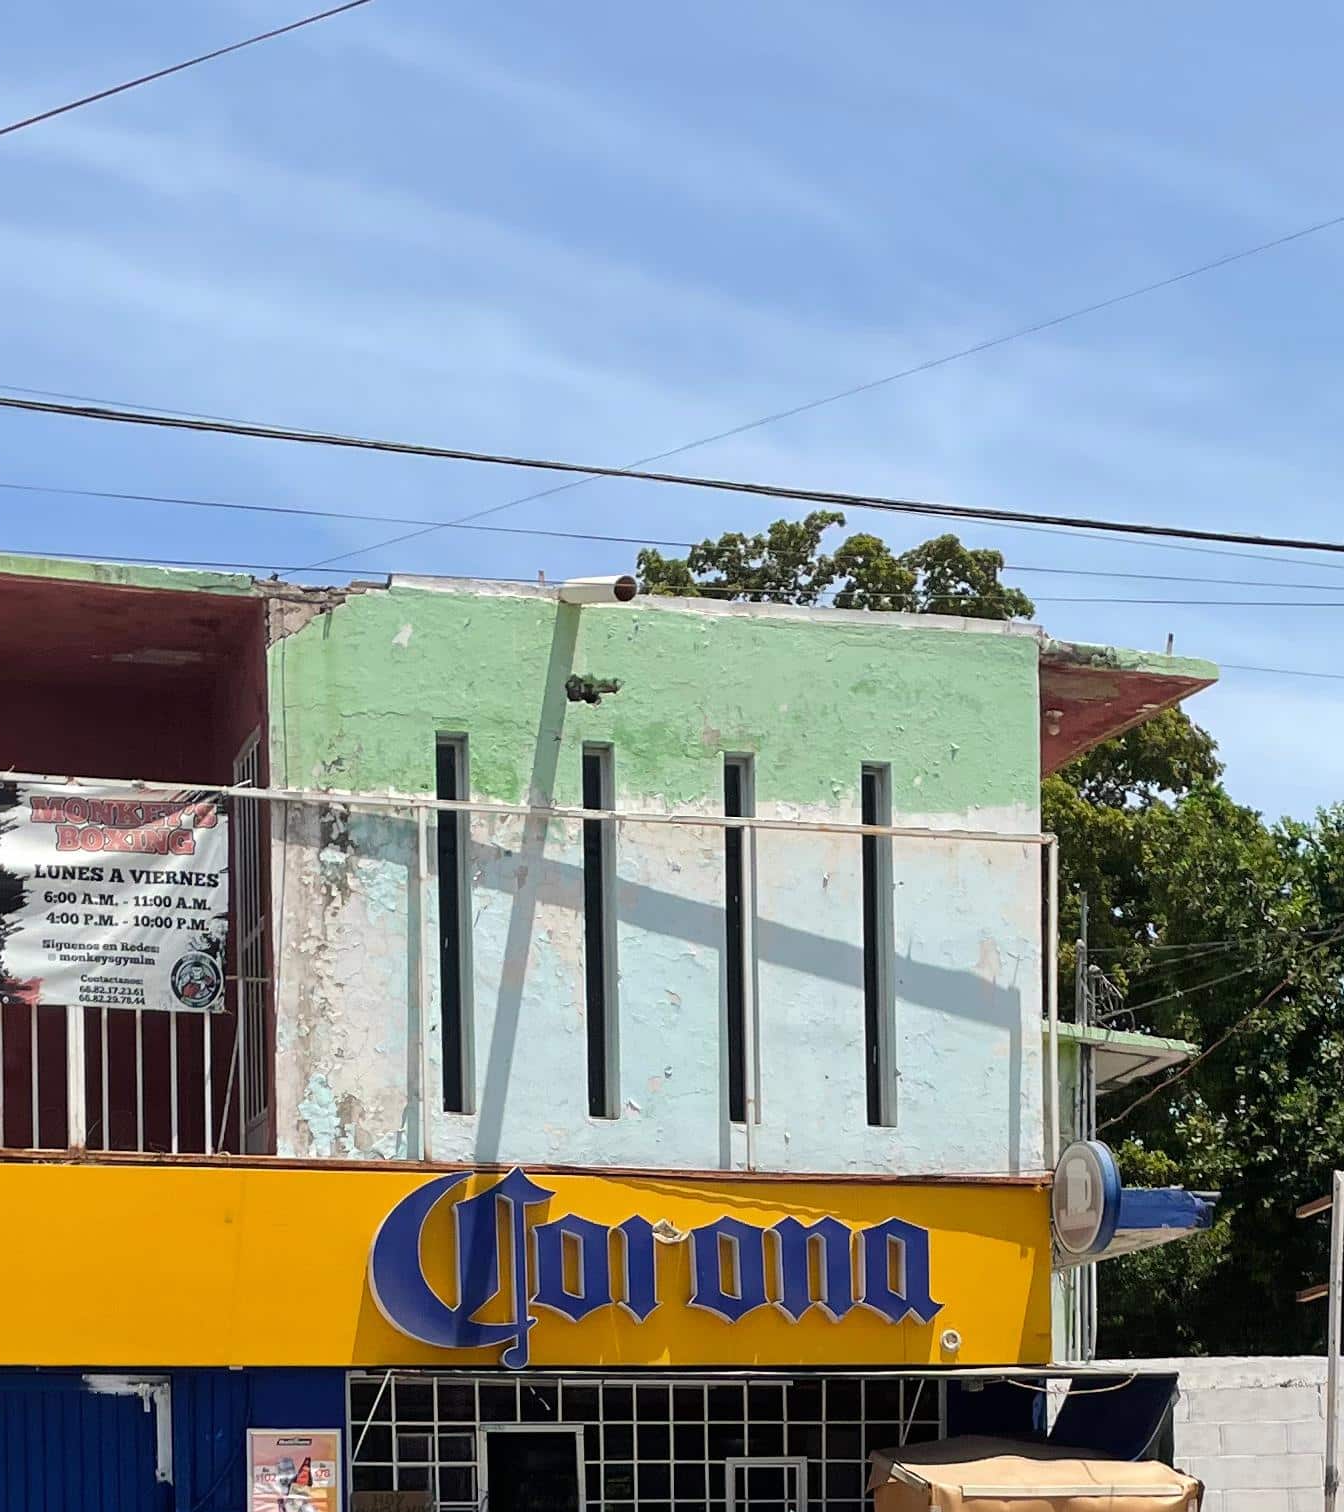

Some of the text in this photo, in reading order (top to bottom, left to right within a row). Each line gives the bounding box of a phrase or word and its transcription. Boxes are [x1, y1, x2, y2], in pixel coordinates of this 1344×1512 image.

[30, 796, 218, 829] MONKEY'S
[55, 824, 196, 856] BOXING
[34, 864, 220, 888] LUNES A VIERNES
[43, 890, 77, 905] 6:00
[81, 893, 119, 907] A.M.
[133, 895, 172, 908] 11:00
[176, 896, 212, 911] A.M.
[46, 912, 80, 925] 4:00
[83, 913, 119, 927] P.M.
[133, 915, 173, 929] 10:00
[176, 917, 210, 932] P.M.
[102, 943, 118, 951] en
[368, 1166, 945, 1369] Corona
